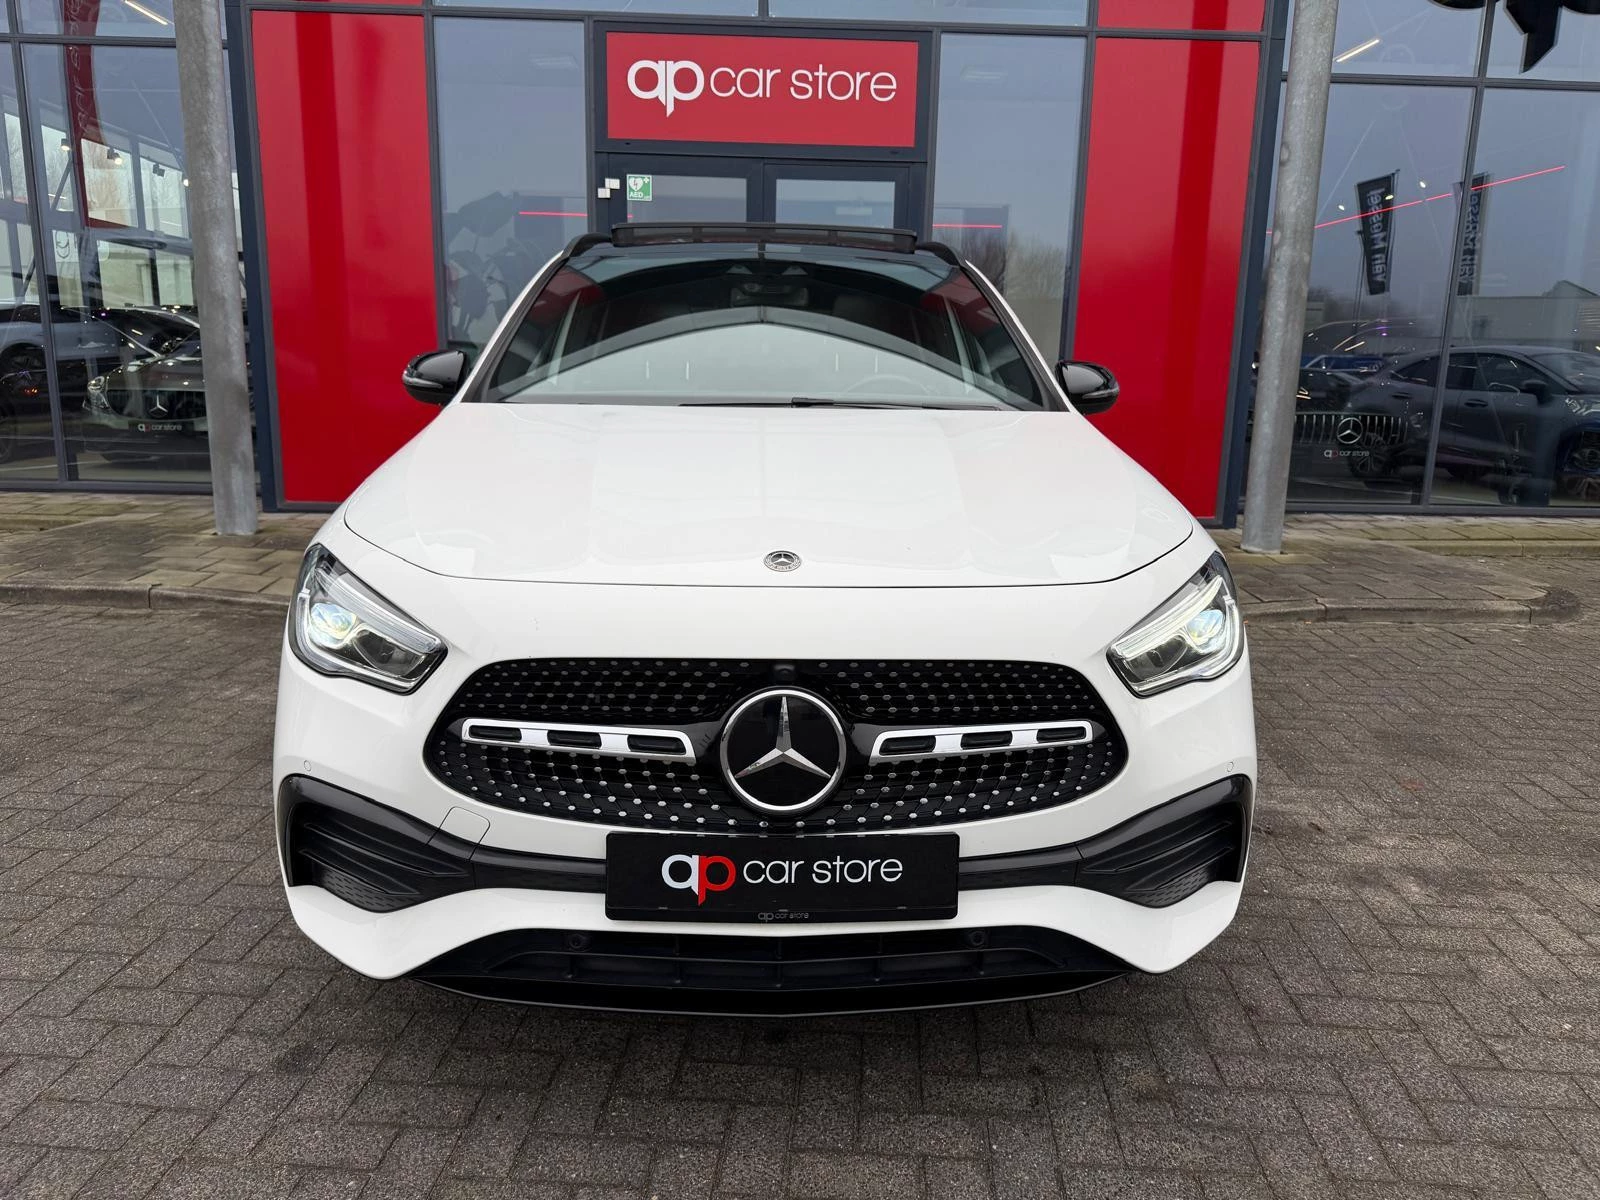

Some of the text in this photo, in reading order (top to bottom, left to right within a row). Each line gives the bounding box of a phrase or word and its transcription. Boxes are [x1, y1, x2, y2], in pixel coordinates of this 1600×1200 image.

[627, 59, 898, 117] ap car store
[661, 854, 904, 907] ap car store
